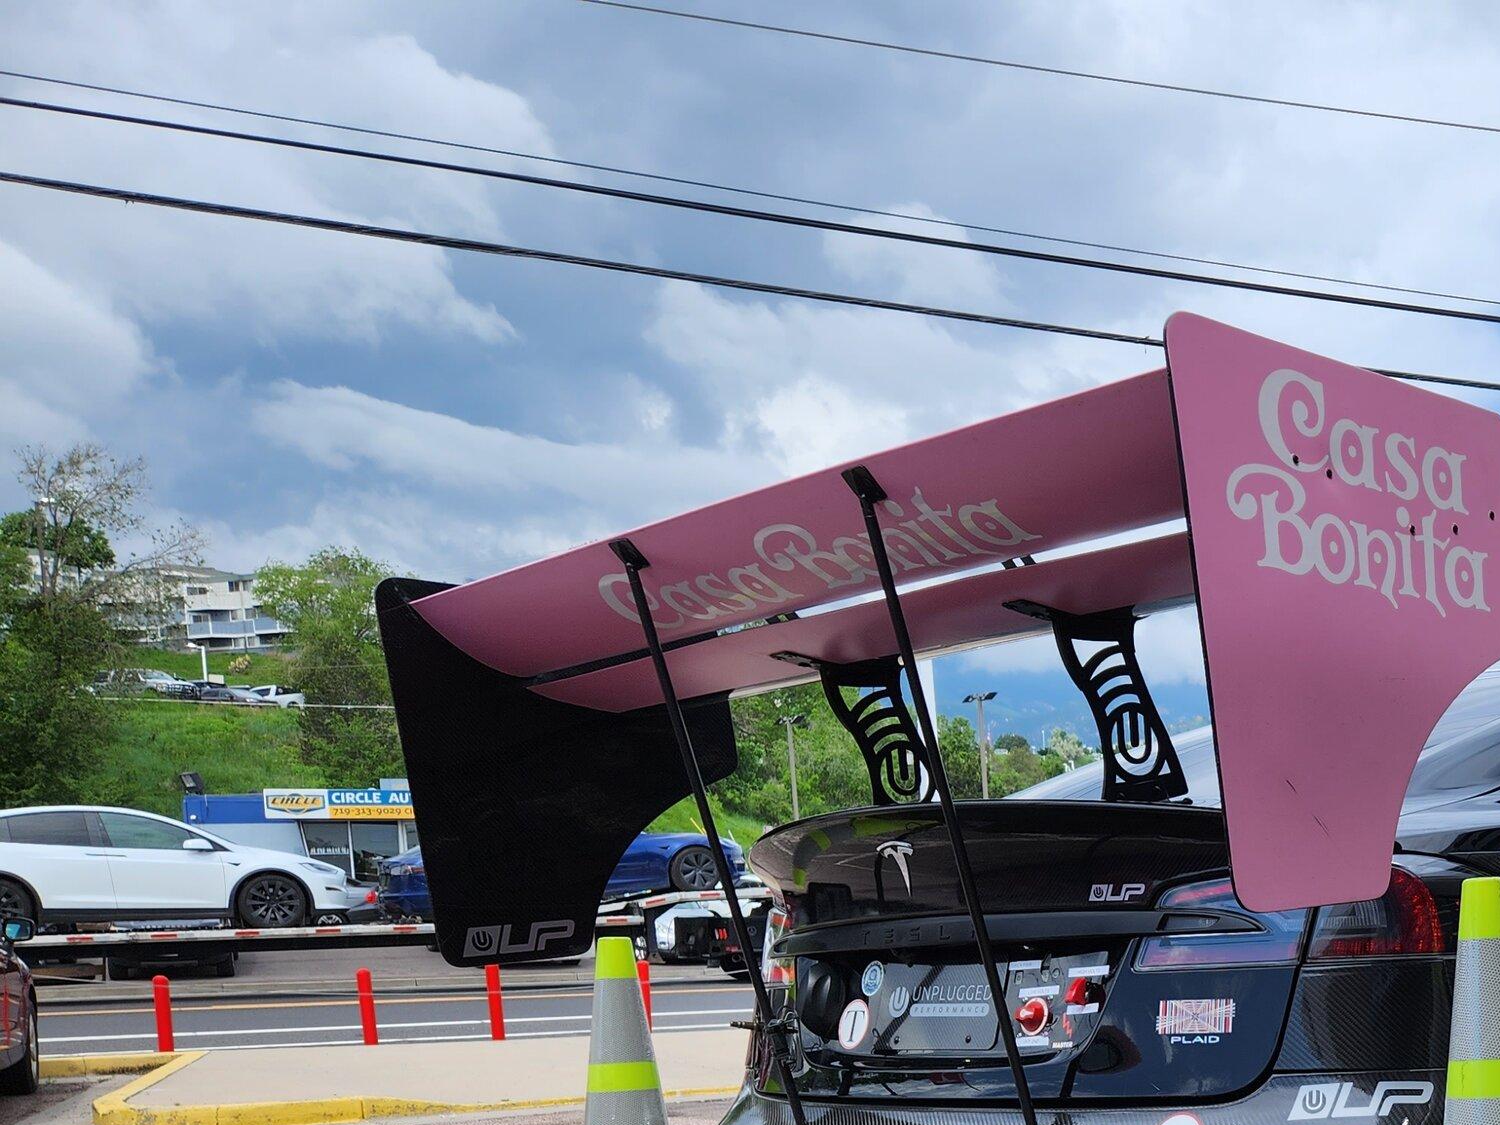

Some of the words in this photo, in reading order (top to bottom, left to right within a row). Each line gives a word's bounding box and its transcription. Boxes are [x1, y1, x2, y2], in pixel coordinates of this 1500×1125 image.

[1258, 368, 1469, 516] Casa
[1226, 463, 1491, 618] Bonita
[598, 562, 806, 630] Casa
[752, 485, 1044, 589] Bonita
[331, 792, 382, 804] CIRCLE
[388, 792, 412, 804] AU
[861, 924, 977, 945] TESL
[912, 984, 993, 1001] UNPLUGGED
[913, 1005, 986, 1014] PERFORMANCE
[844, 1010, 866, 1042] T
[1170, 1035, 1220, 1045] PLAID
